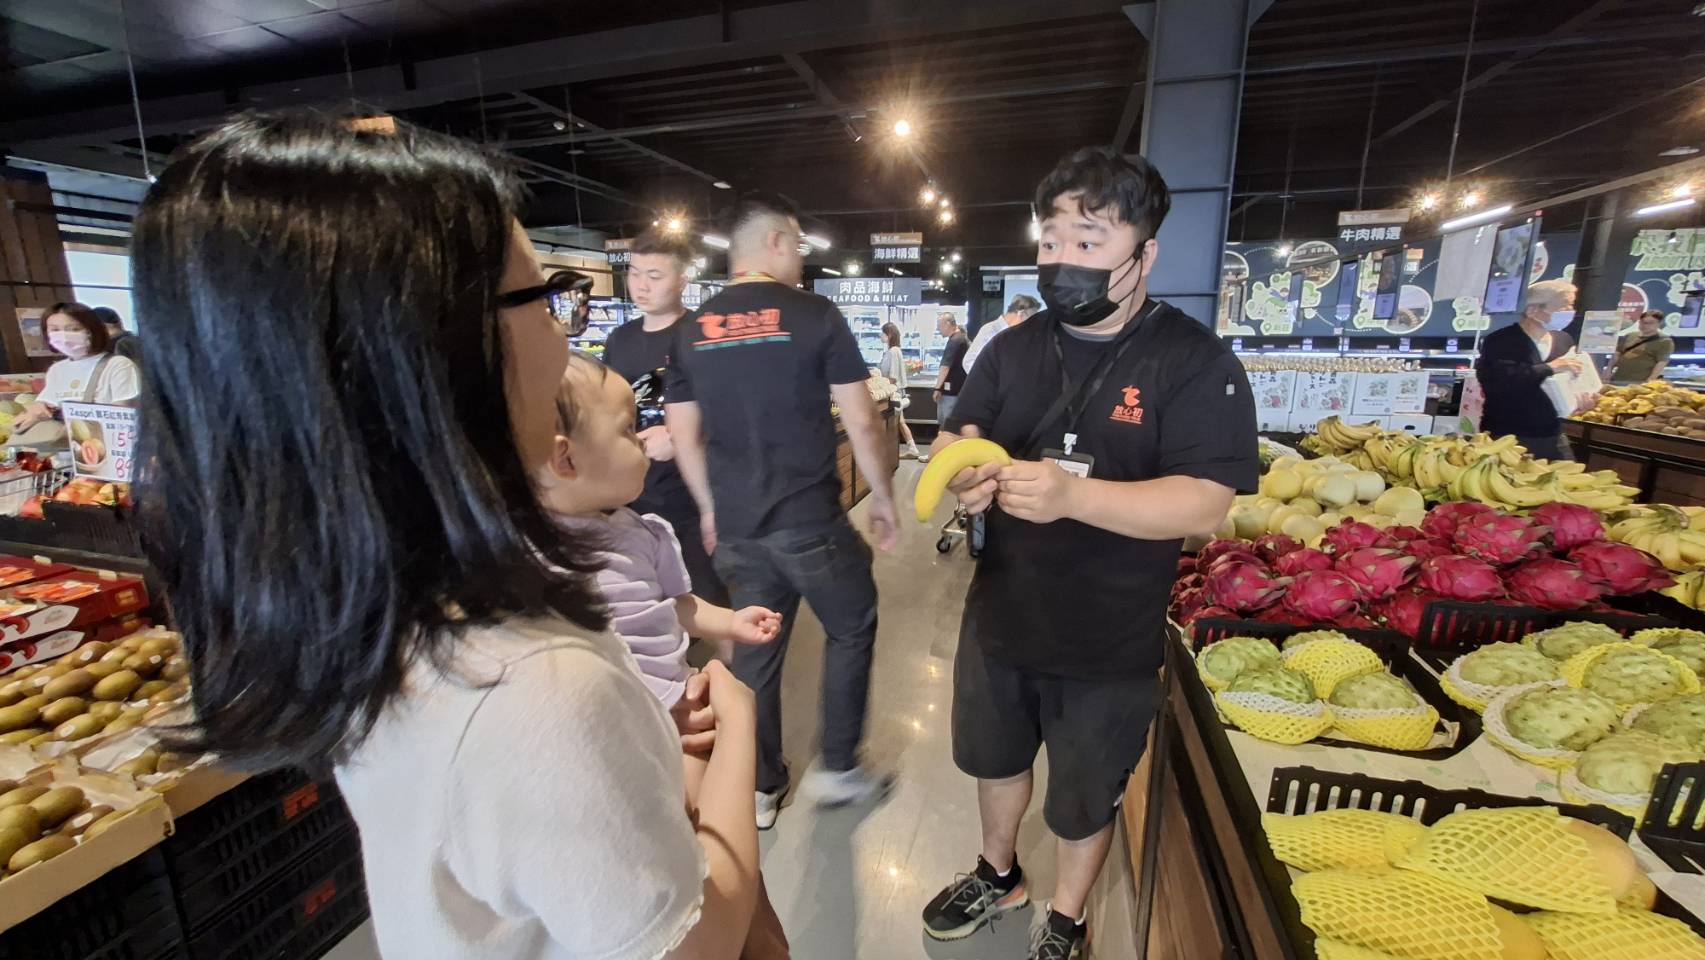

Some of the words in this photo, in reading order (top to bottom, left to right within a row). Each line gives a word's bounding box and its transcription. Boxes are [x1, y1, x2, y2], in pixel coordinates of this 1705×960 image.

[1340, 227, 1401, 241] 牛肉精選
[874, 247, 919, 260] 海鮮精選
[839, 280, 894, 294] 肉品海鮮
